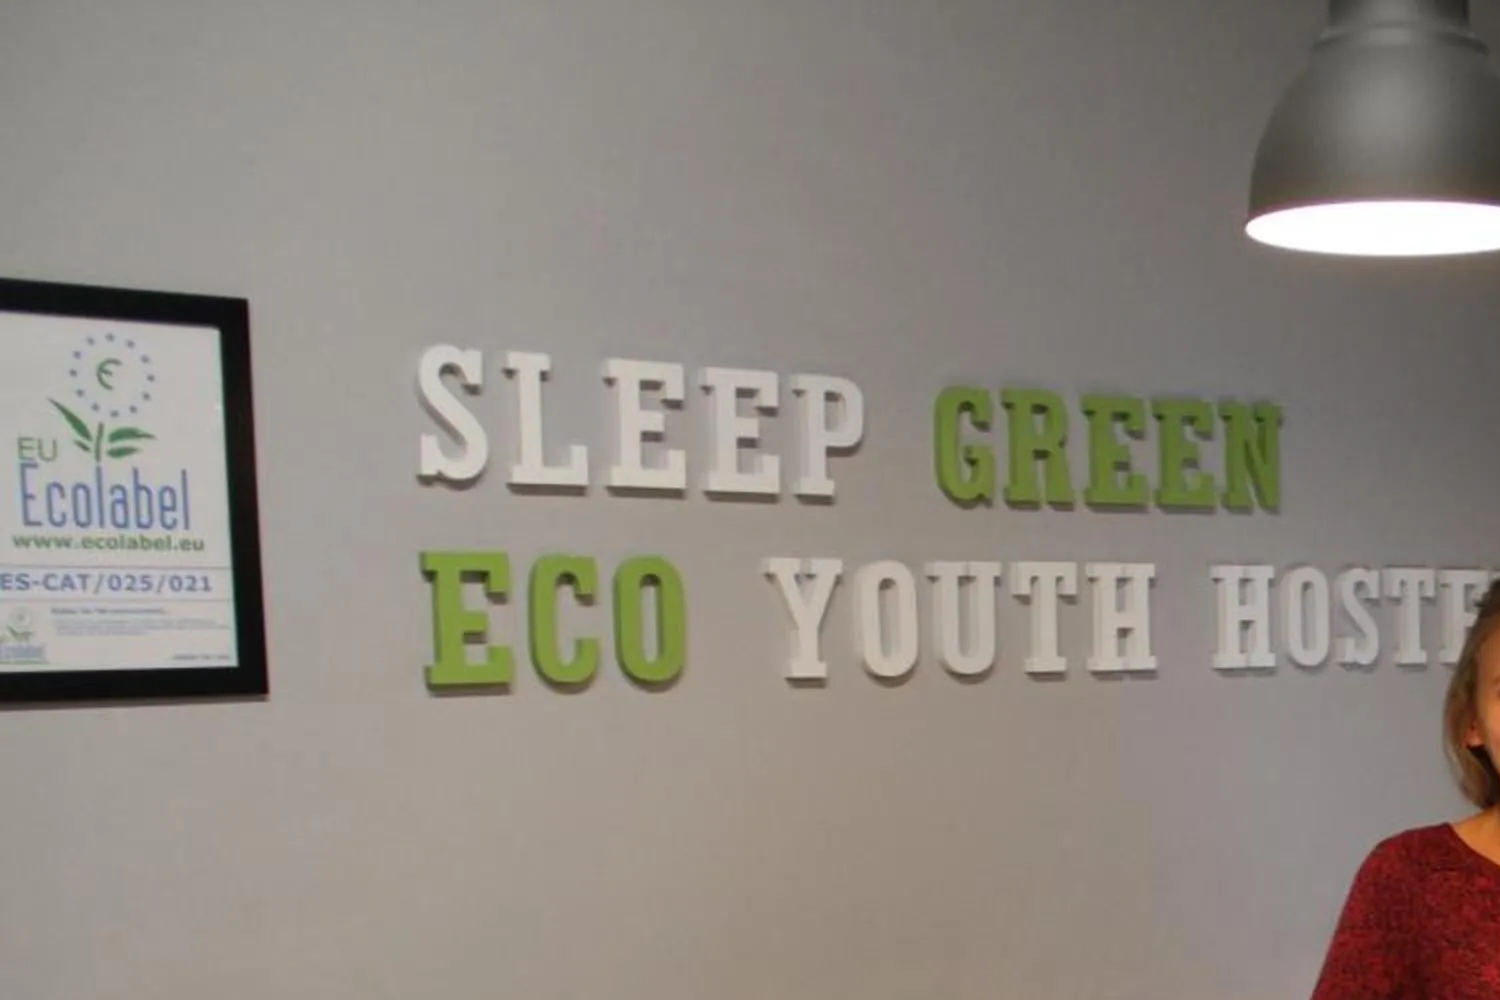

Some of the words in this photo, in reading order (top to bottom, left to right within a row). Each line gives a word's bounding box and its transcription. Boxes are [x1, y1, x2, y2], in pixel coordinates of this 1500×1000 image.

[17, 436, 58, 462] EU
[417, 343, 865, 500] SLEEP
[933, 385, 1283, 513] GREEN
[19, 462, 191, 531] Ecolabel
[12, 533, 206, 553] www.ecolabel.eu
[0, 573, 213, 595] ES-CAT/025/021
[418, 550, 687, 692] ECO
[763, 557, 1159, 685] YOUTH
